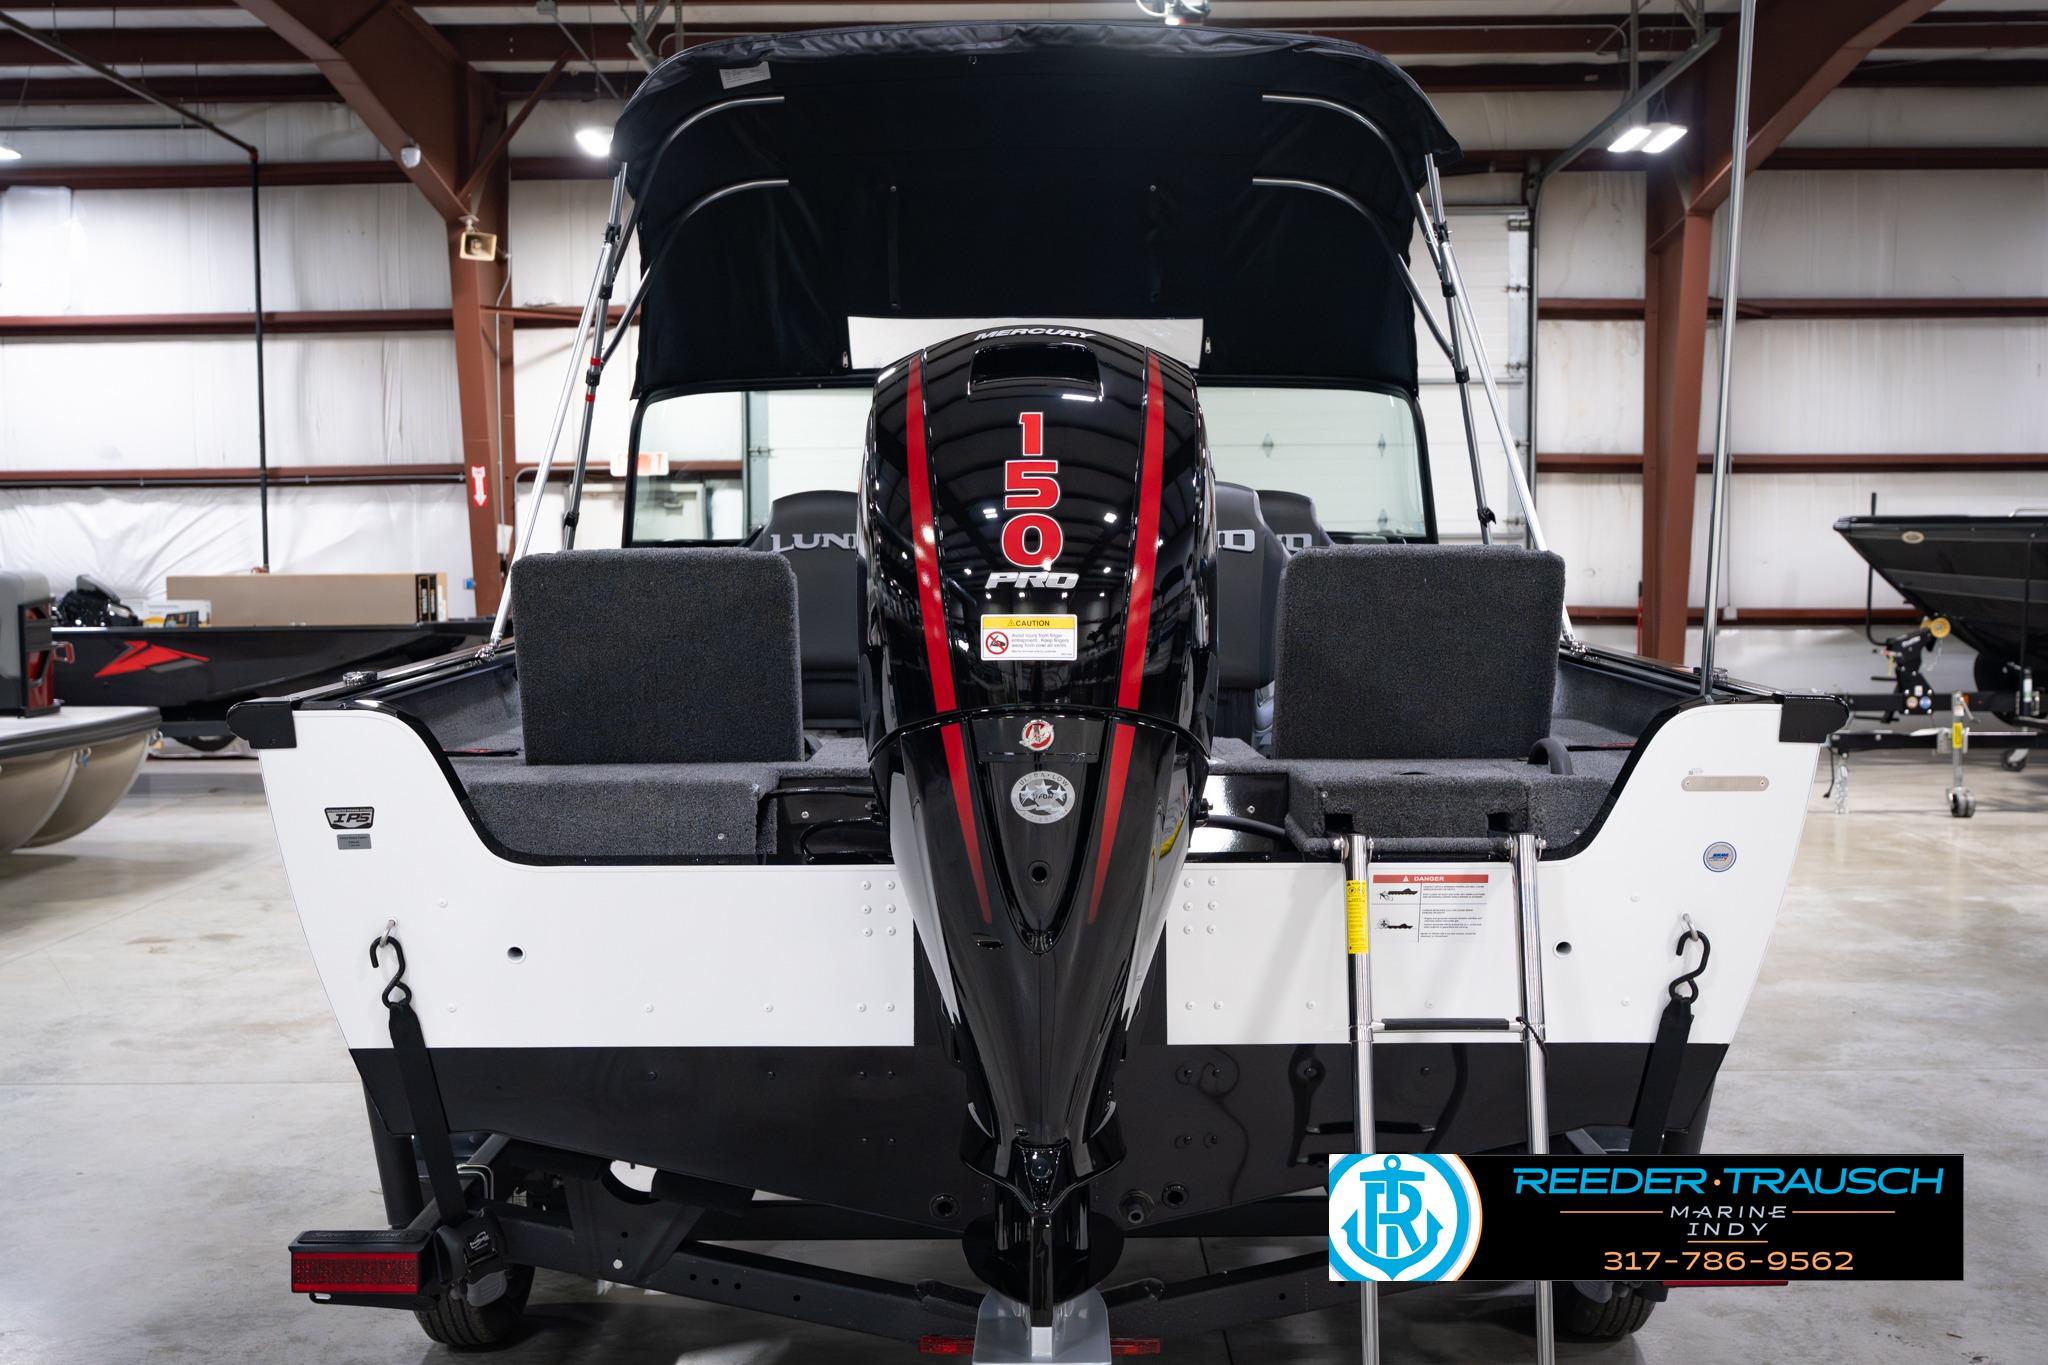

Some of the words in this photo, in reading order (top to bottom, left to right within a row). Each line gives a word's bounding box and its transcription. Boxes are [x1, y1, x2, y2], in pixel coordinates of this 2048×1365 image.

[974, 328, 1097, 341] MERCURY
[1002, 411, 1063, 568] 150
[771, 533, 857, 552] LUN
[985, 572, 1079, 589] PRO
[1015, 619, 1050, 627] CAUTION
[1051, 774, 1070, 787] LOW
[333, 813, 371, 823] IPS
